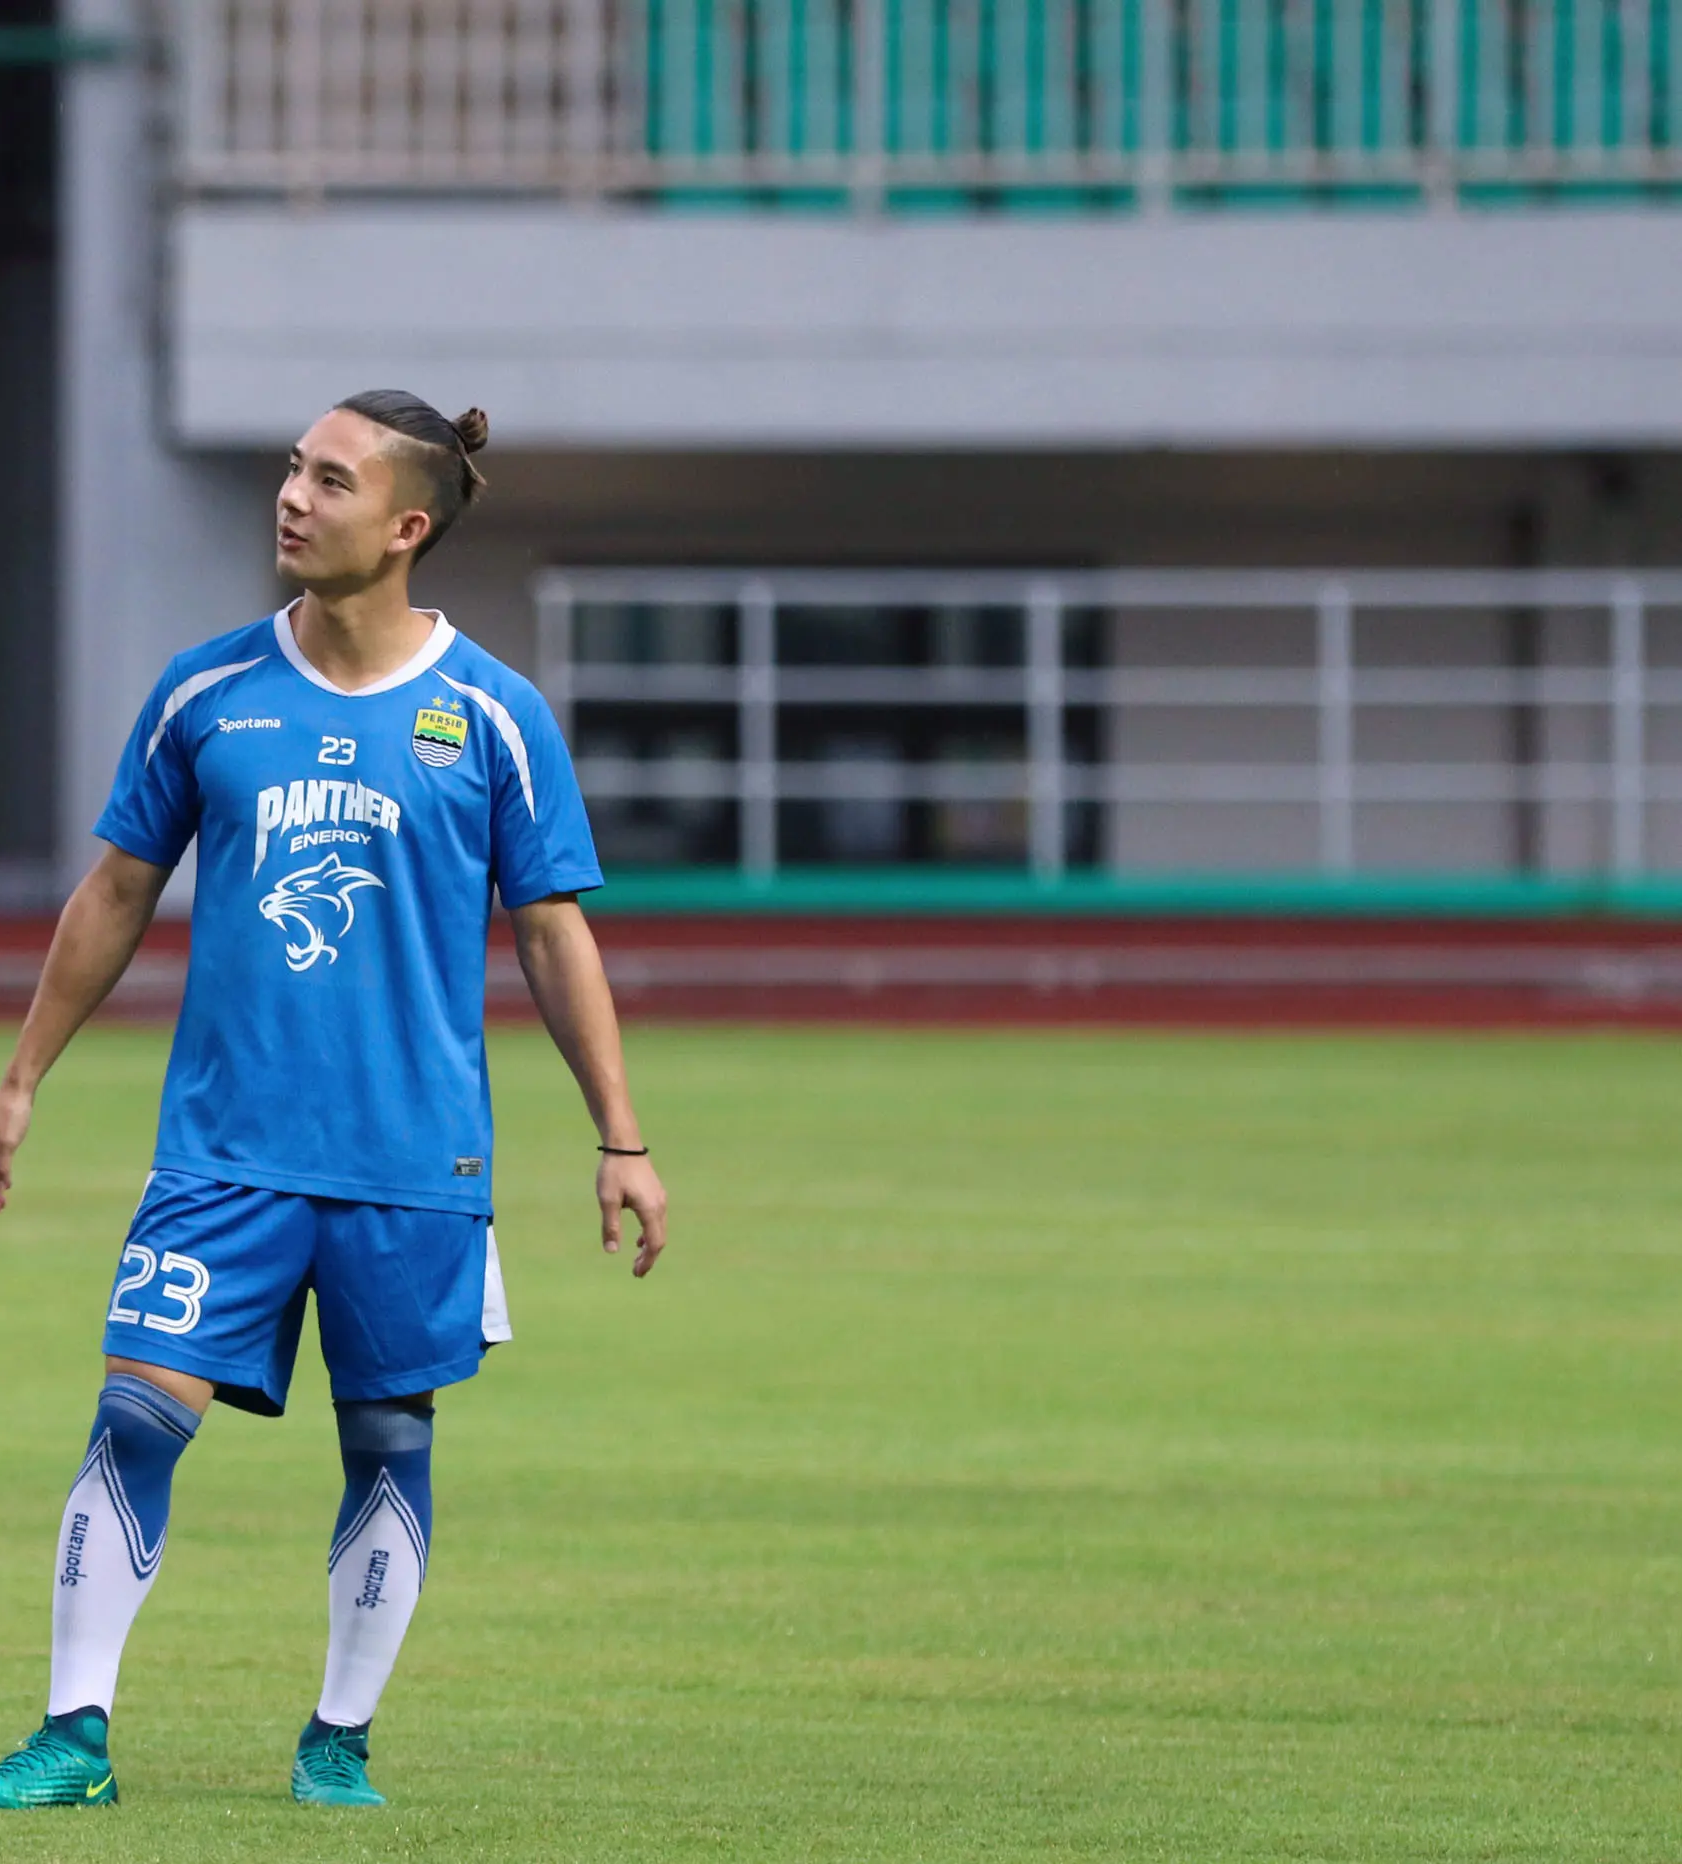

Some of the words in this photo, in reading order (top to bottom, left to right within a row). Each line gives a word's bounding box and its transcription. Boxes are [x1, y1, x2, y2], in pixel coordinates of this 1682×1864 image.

[218, 717, 282, 734] Sportama
[422, 711, 463, 729] PERSIB
[317, 735, 357, 766] 23
[252, 778, 401, 881] PANTHER
[290, 829, 372, 854] ENERGY
[107, 1243, 211, 1335] 23
[60, 1512, 90, 1587] Sportama
